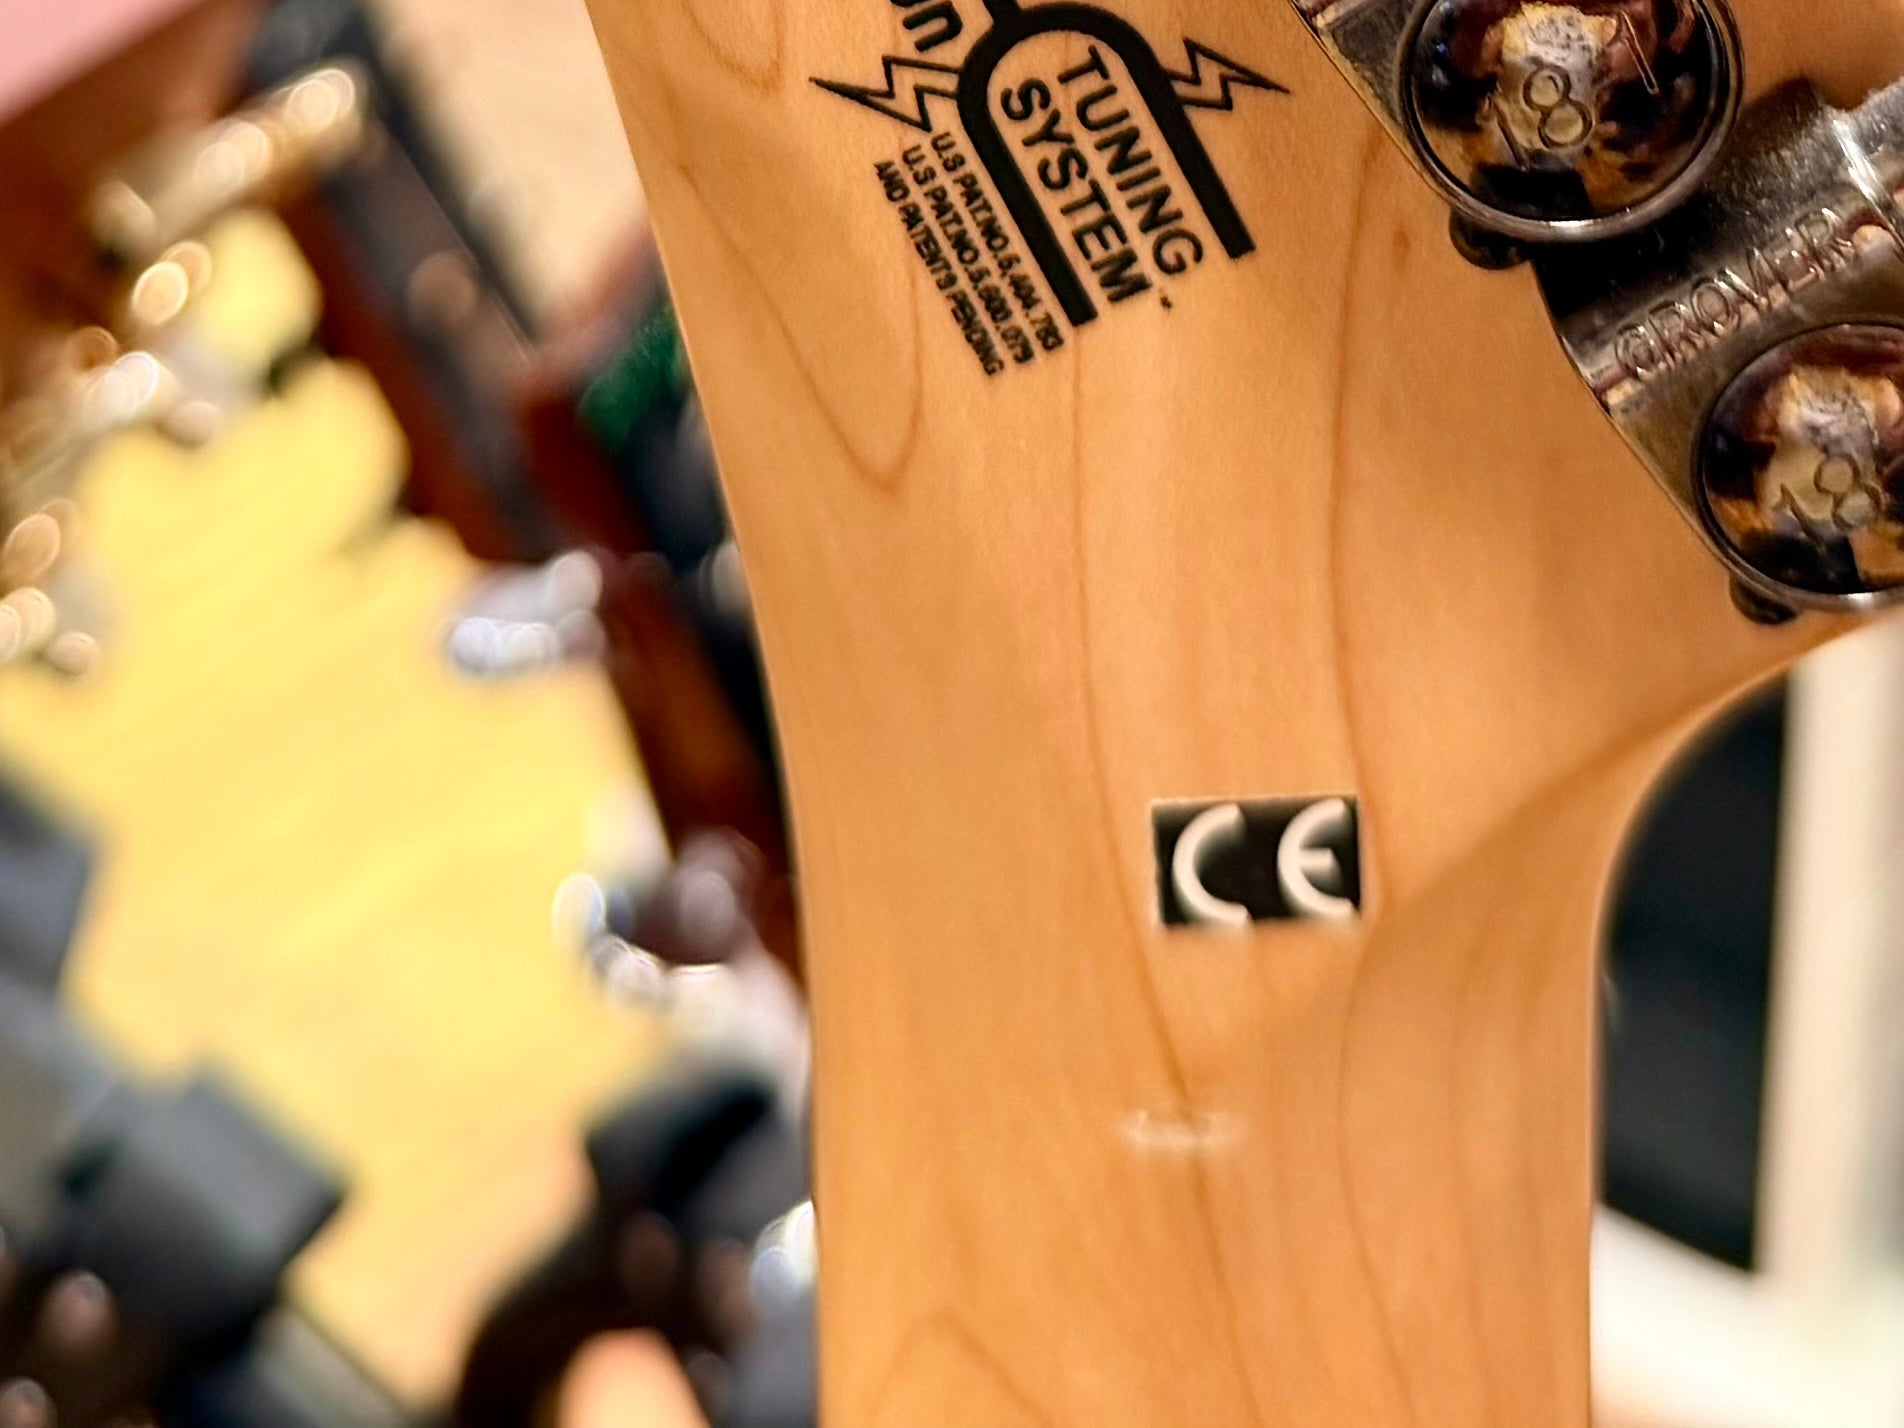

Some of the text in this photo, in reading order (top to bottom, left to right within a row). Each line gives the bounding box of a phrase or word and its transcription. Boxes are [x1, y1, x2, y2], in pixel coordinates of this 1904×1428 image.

[1001, 77, 1152, 304] SYSTEM
[1057, 44, 1203, 275] TUNING
[873, 160, 1005, 377] AND PATENTS PENDING
[1613, 208, 1853, 381] GROVER
[1172, 797, 1354, 926] CE
